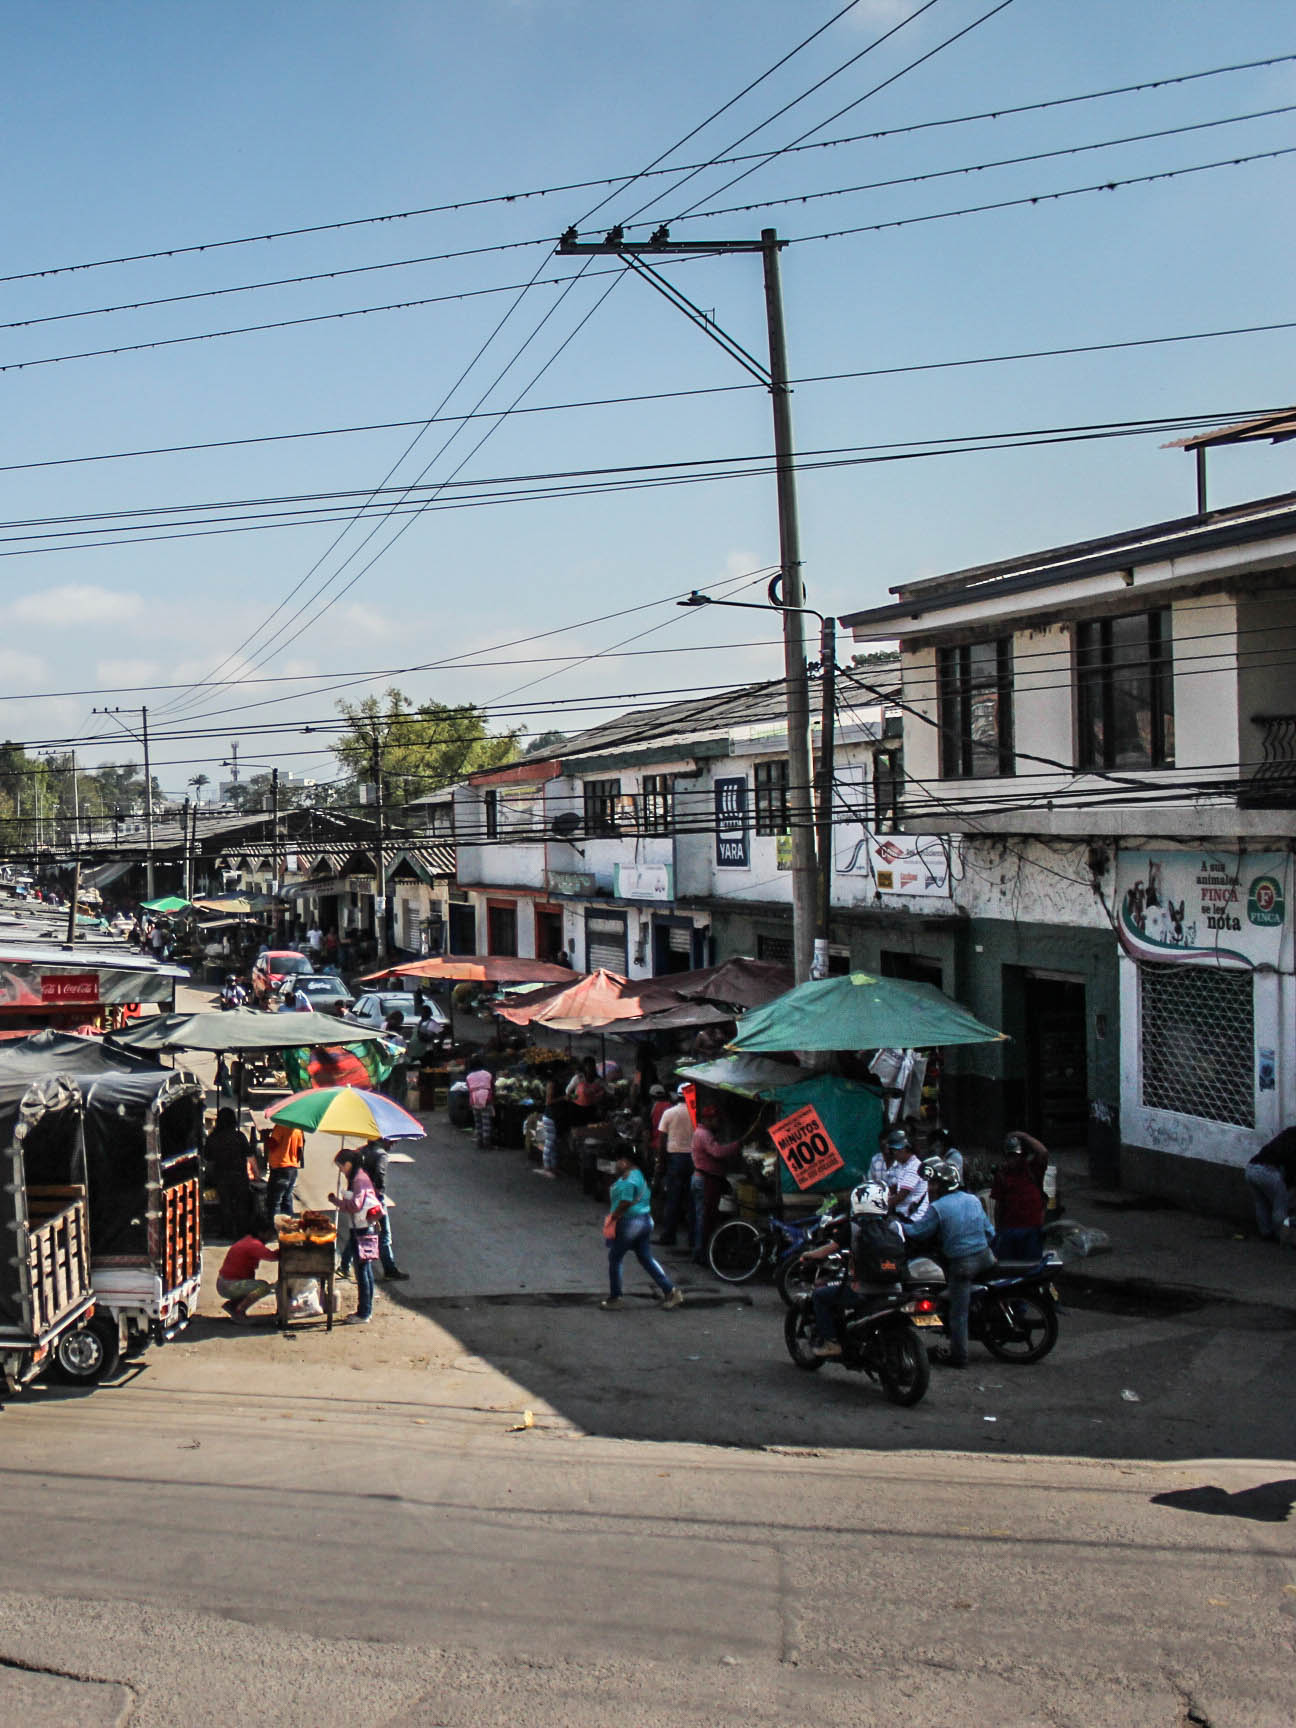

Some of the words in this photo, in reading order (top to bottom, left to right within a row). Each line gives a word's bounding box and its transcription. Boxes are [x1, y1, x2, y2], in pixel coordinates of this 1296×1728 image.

[720, 843, 744, 860] YARA
[1201, 887, 1239, 902] FINCA
[1207, 914, 1241, 931] nota
[1250, 912, 1281, 922] FINCA
[778, 1119, 820, 1151] MINUTOS
